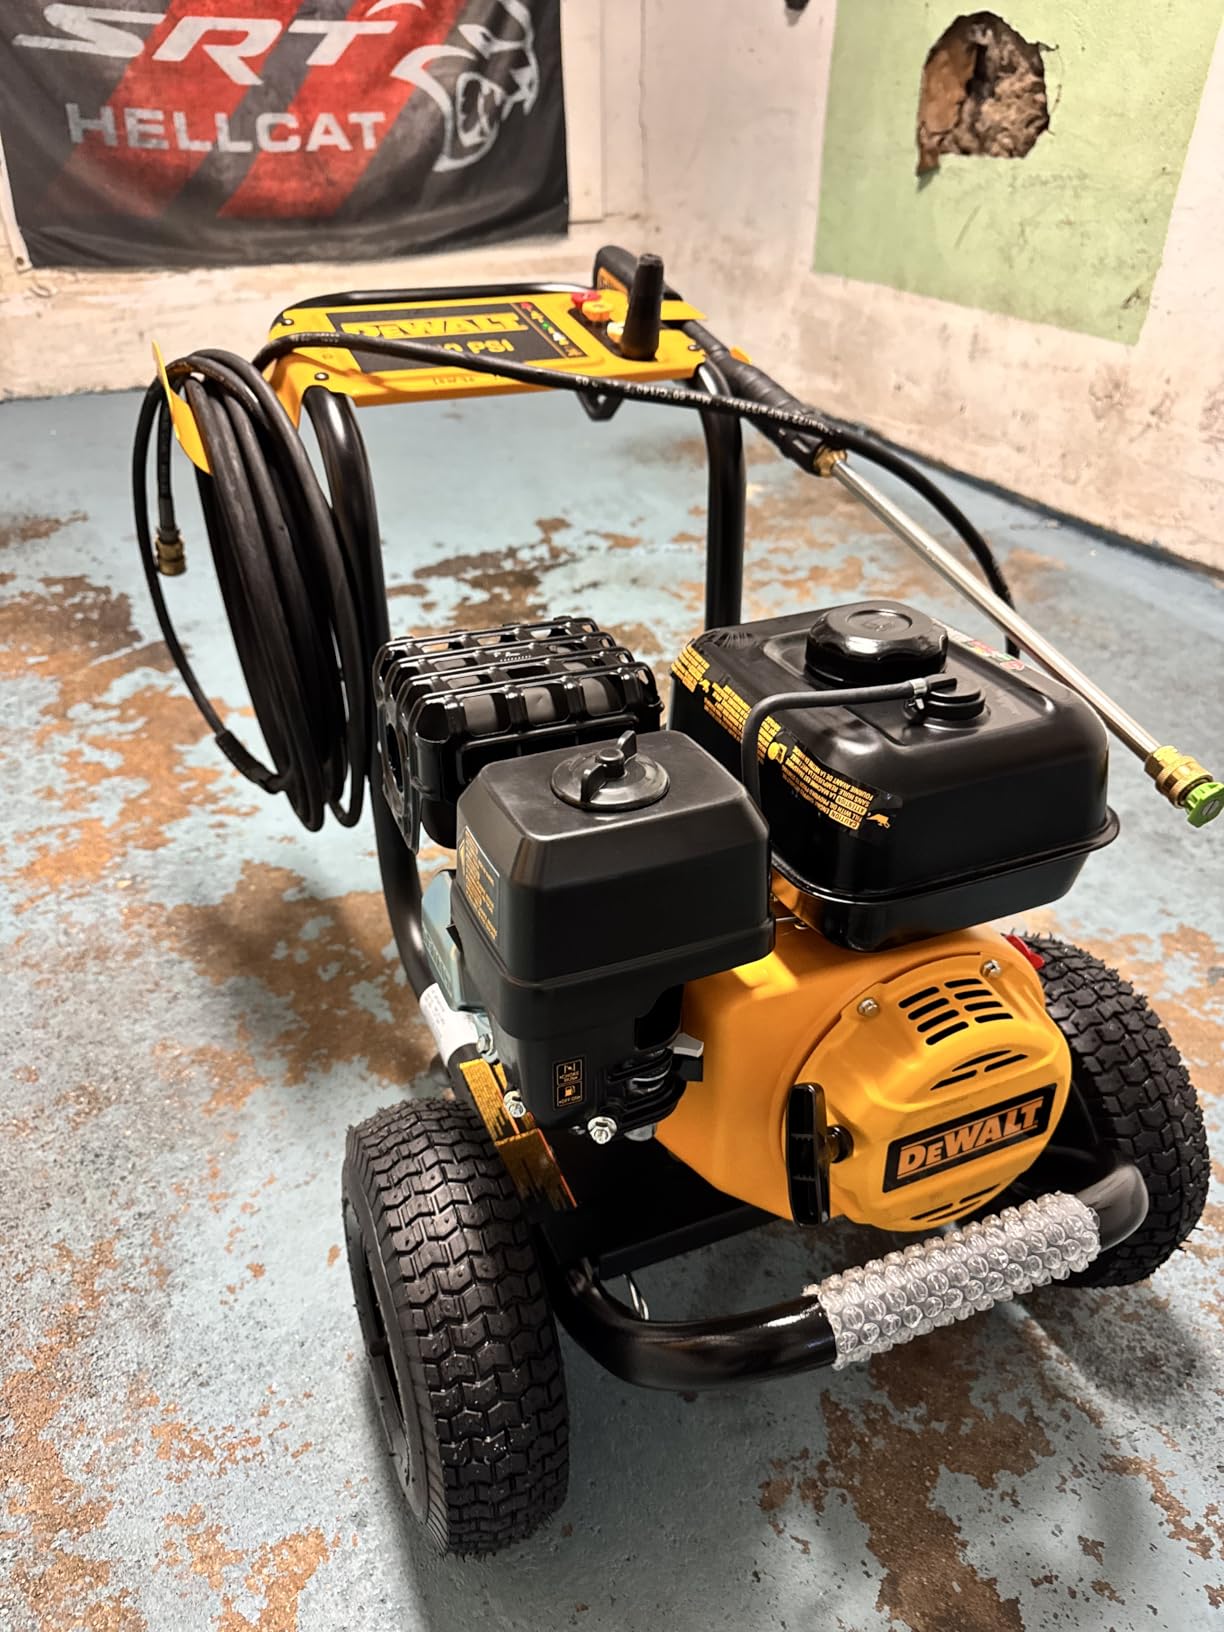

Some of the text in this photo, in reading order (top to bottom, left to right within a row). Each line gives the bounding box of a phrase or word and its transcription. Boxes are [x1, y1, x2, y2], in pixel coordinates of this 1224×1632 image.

[14, 3, 397, 86] SRT
[67, 103, 386, 153] HELLCAT
[474, 339, 515, 355] PSI
[897, 1100, 1043, 1175] DEWALT
